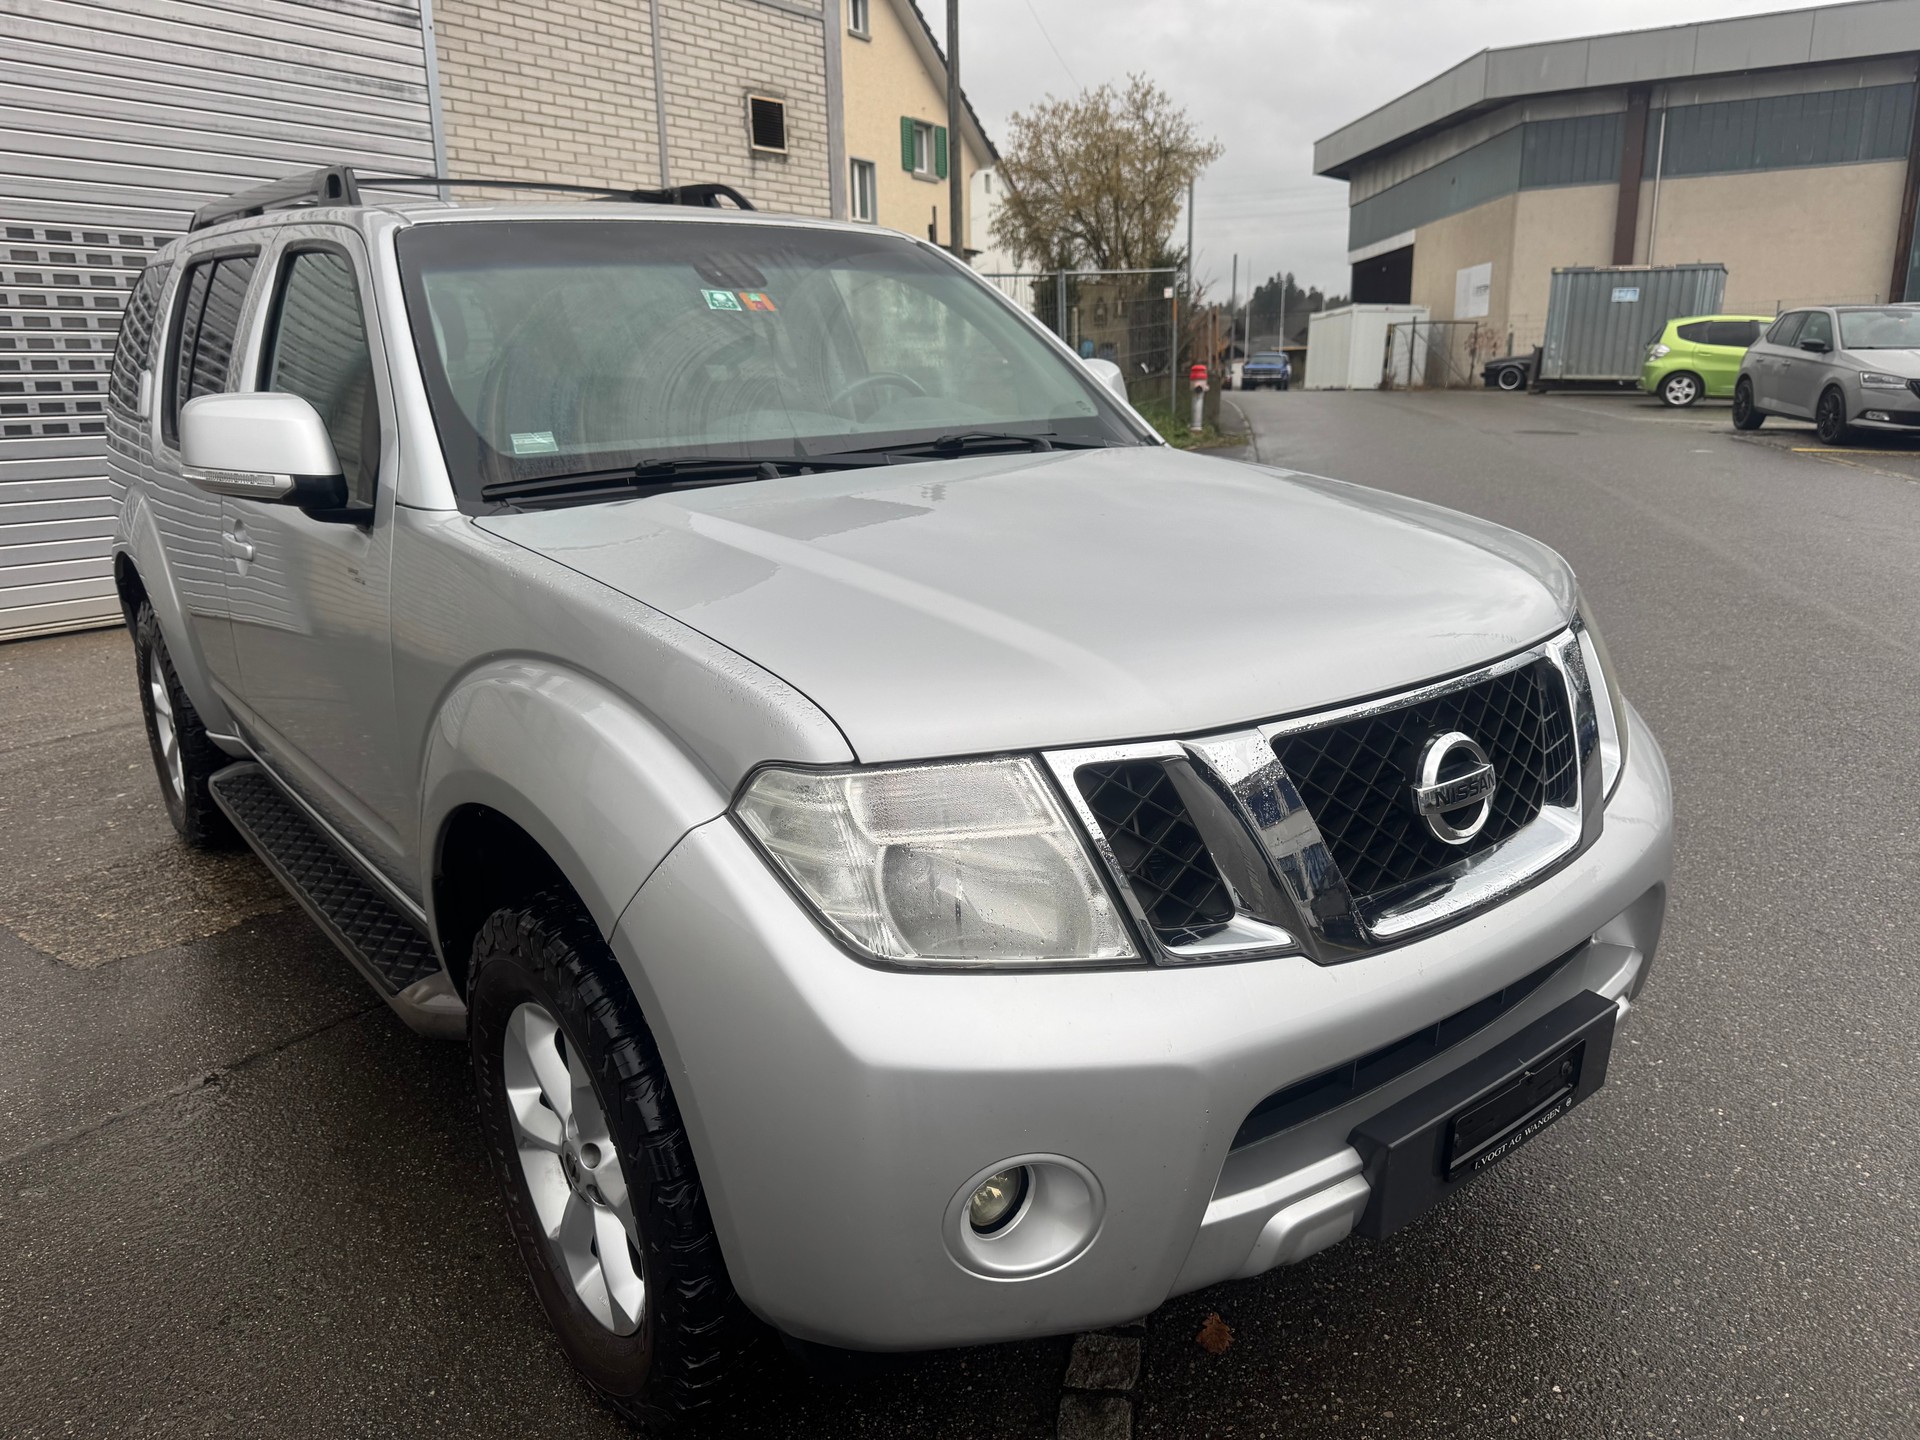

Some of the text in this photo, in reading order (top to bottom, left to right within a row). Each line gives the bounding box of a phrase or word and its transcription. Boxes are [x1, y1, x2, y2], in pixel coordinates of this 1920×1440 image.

[1434, 773, 1495, 809] NISSAN
[1481, 1143, 1507, 1165] VOGT
[1508, 1133, 1522, 1148] AG
[1524, 1105, 1561, 1136] WANGEN
